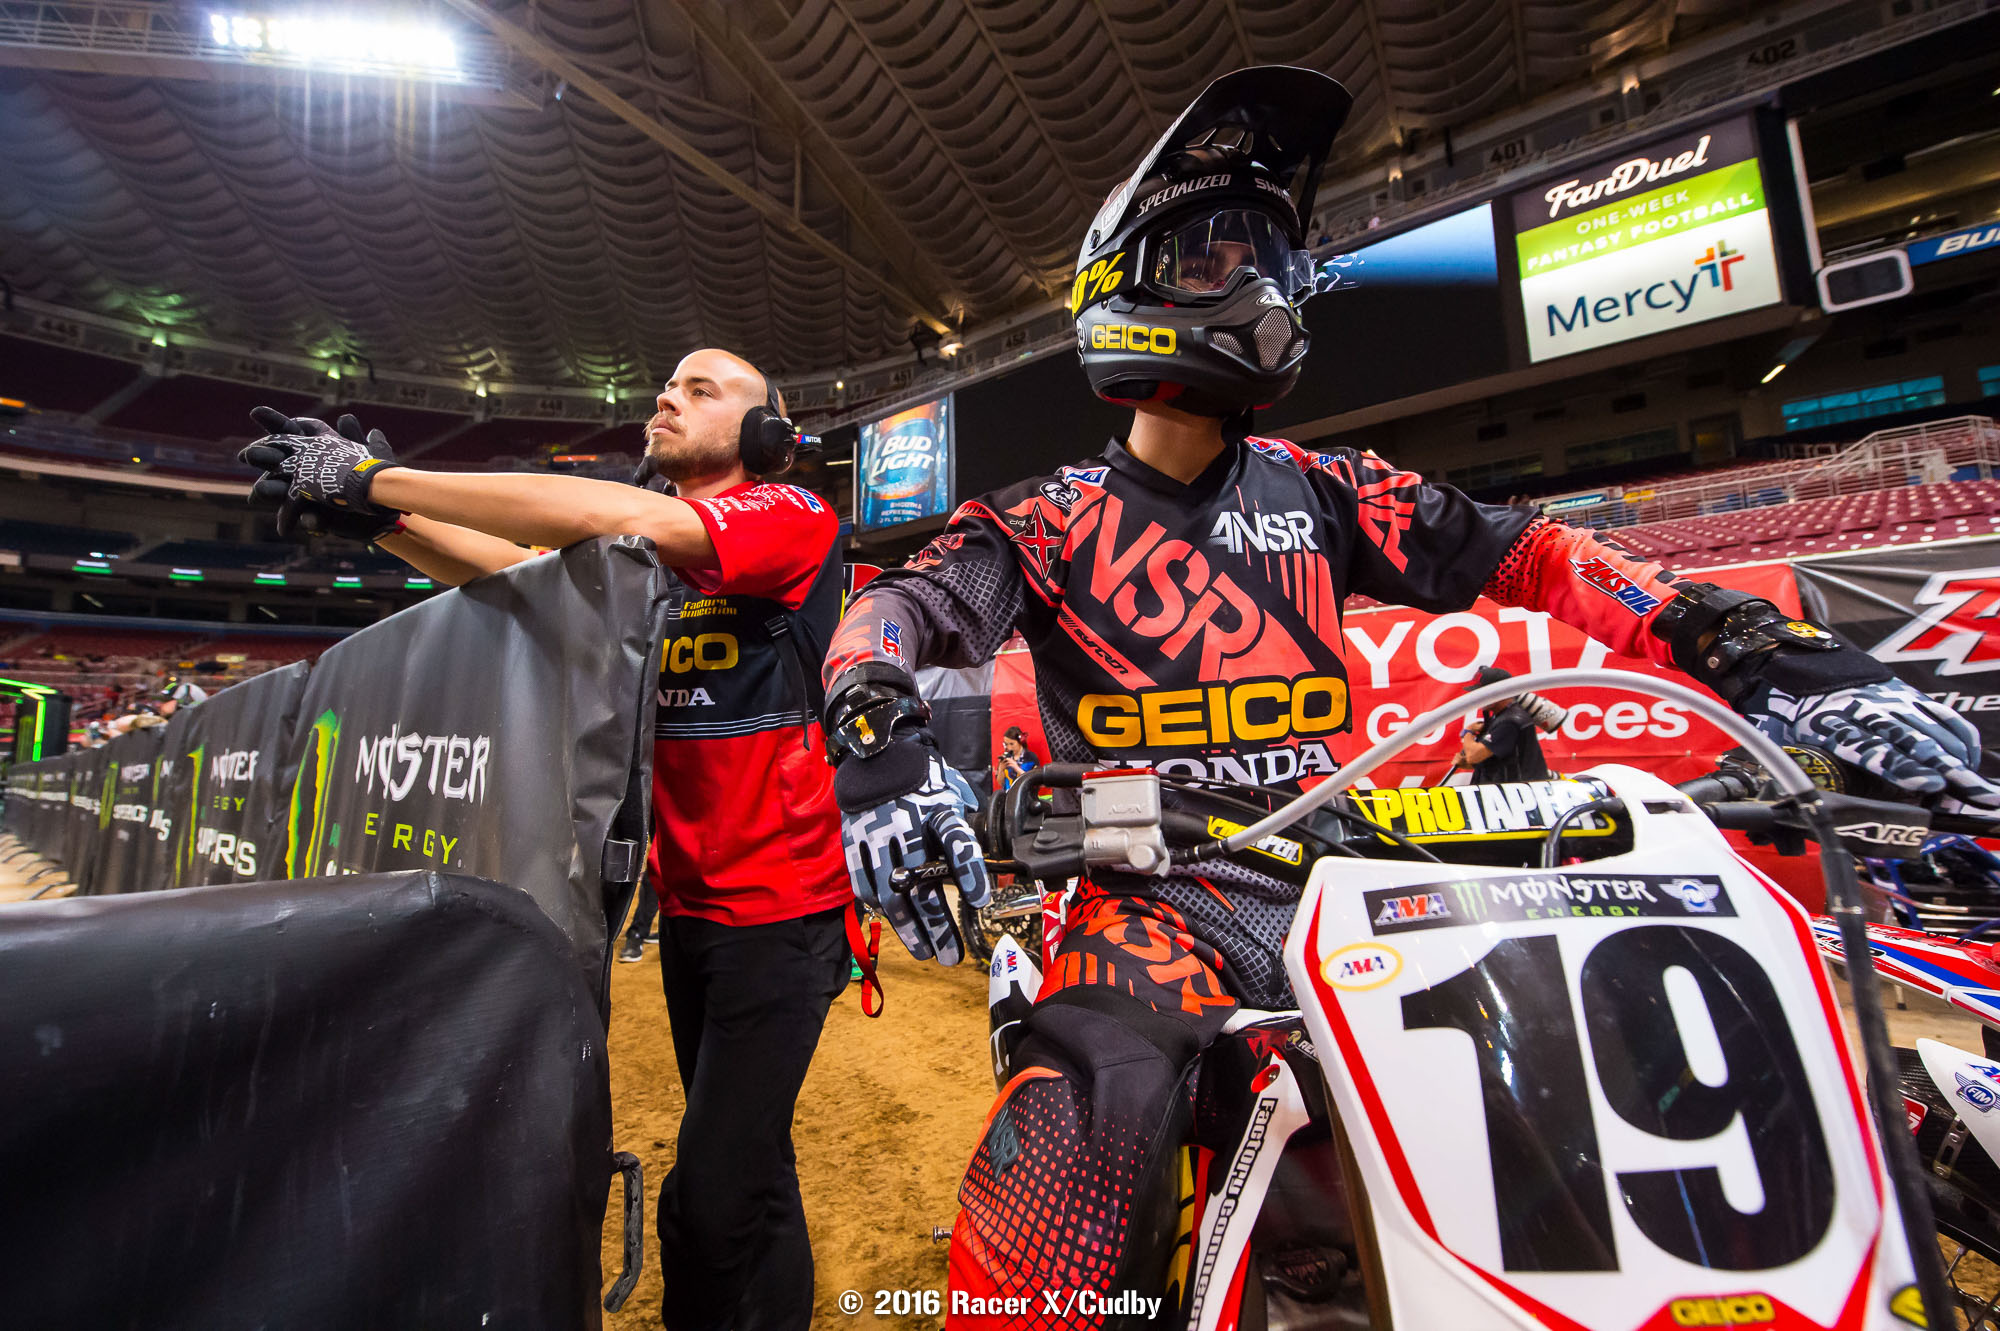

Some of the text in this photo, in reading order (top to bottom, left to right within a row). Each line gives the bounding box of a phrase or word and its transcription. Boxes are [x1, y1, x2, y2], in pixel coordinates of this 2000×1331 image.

[1748, 39, 1796, 65] 402
[1491, 139, 1526, 163] 401
[1544, 135, 1711, 218] FanDuel
[1136, 173, 1231, 217] SPECIALIZED
[1576, 188, 1690, 235] ONE-WEEK
[1527, 192, 1755, 271] FANTASY FOOTBALL
[1547, 272, 1701, 337] Mercy
[1091, 323, 1177, 355] GEICO
[881, 435, 933, 457] BUD
[871, 451, 935, 478] LIGHT
[1208, 511, 1319, 554] ANSR
[1569, 556, 1663, 617] AMSOIL
[1076, 676, 1347, 748] GEICO
[1834, 822, 1929, 847] ARC
[1375, 893, 1452, 927] AMA
[1527, 906, 1642, 920] ENERGY
[1339, 955, 1386, 979] AMA
[1401, 925, 1836, 1273] 19
[1968, 1088, 1992, 1104] FIM
[1226, 1098, 1279, 1199] Factory
[1670, 1293, 1776, 1327] GEICO
